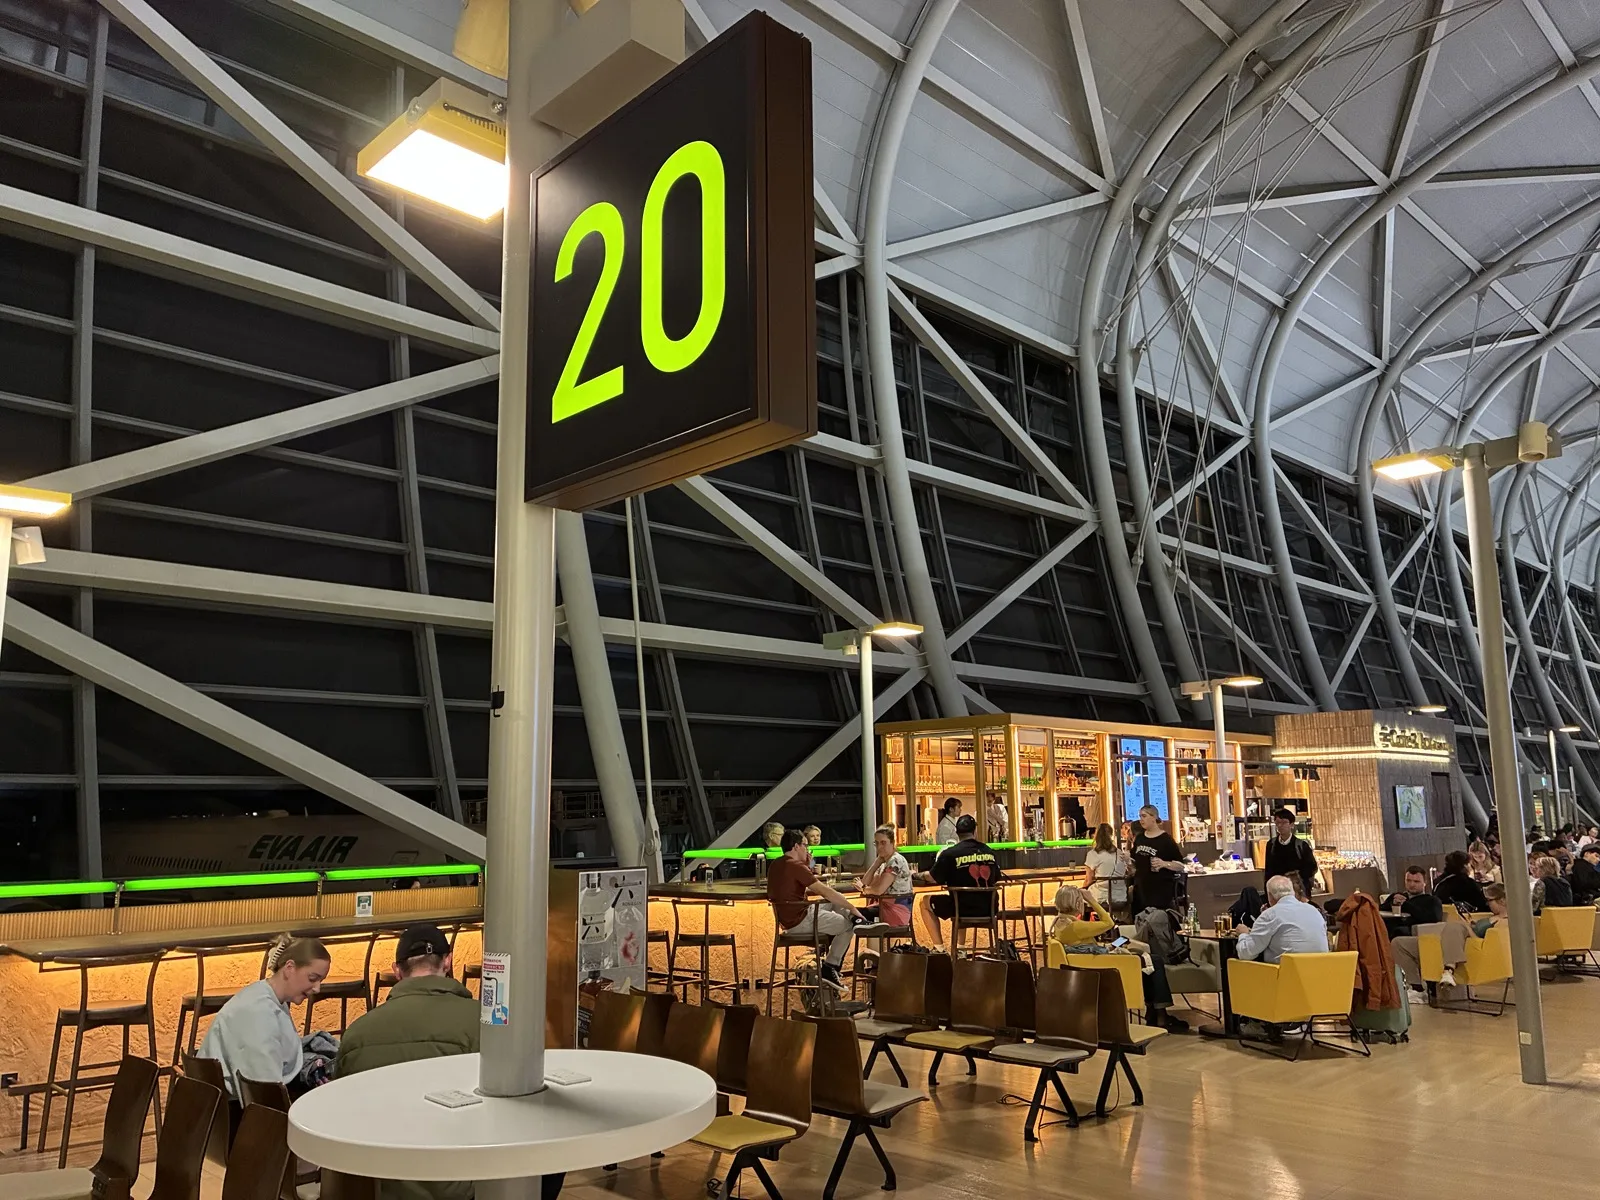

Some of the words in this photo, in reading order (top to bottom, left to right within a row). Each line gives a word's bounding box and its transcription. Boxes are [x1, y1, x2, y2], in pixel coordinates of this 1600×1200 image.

[552, 140, 725, 424] 20
[248, 834, 304, 861] EVA
[297, 836, 358, 863] AIR
